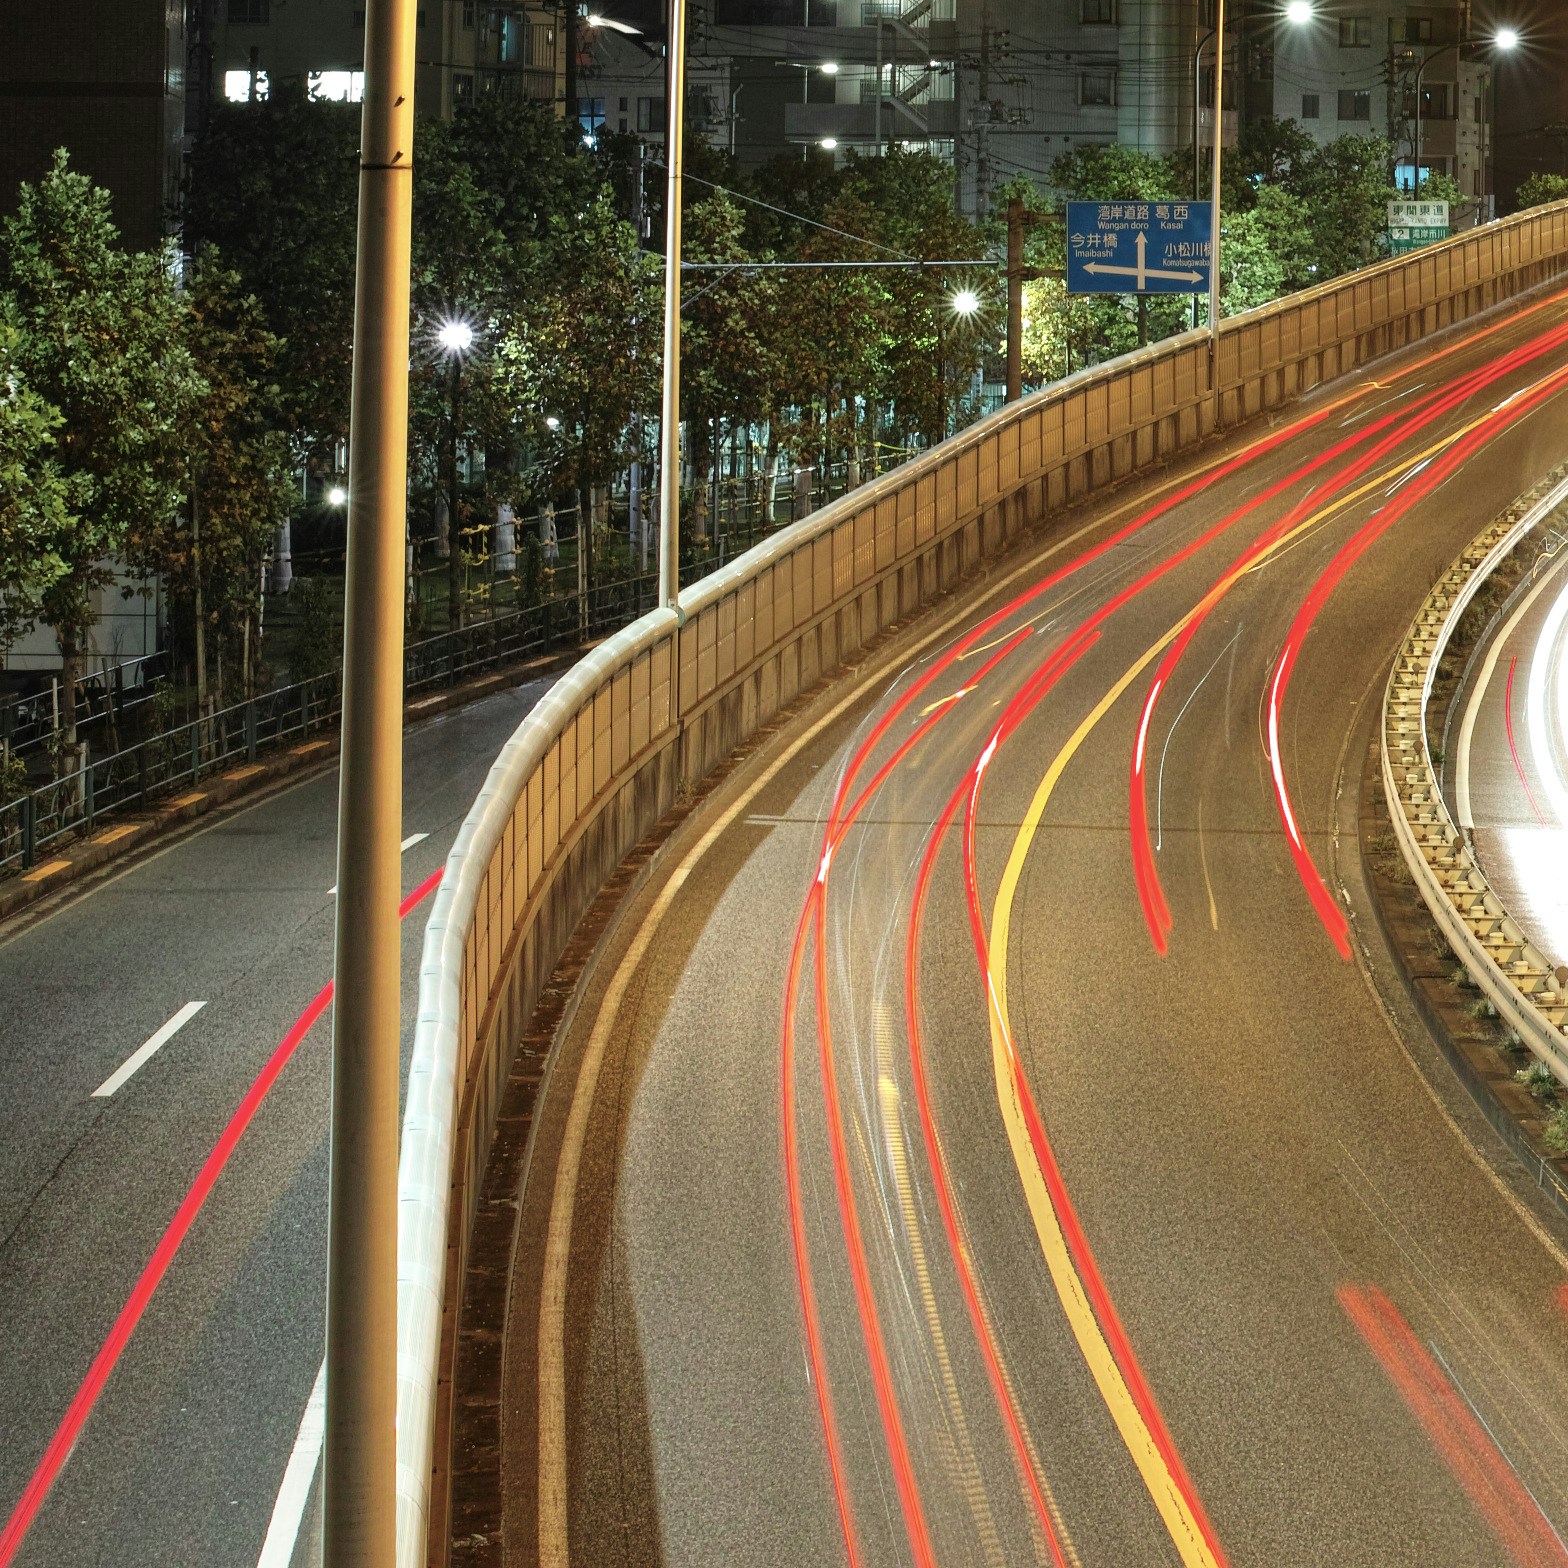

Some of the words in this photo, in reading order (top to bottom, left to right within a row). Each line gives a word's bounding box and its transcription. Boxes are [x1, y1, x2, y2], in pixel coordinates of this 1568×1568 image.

[1098, 205, 1149, 220] 湾岸道路
[1155, 205, 1188, 220] 葛西
[1098, 221, 1129, 231] Wangan
[1130, 221, 1149, 230] doro
[1160, 221, 1183, 230] Kasai
[1397, 229, 1404, 238] 2
[1070, 233, 1118, 248] 今井橋
[1075, 249, 1113, 258] Imaibashi
